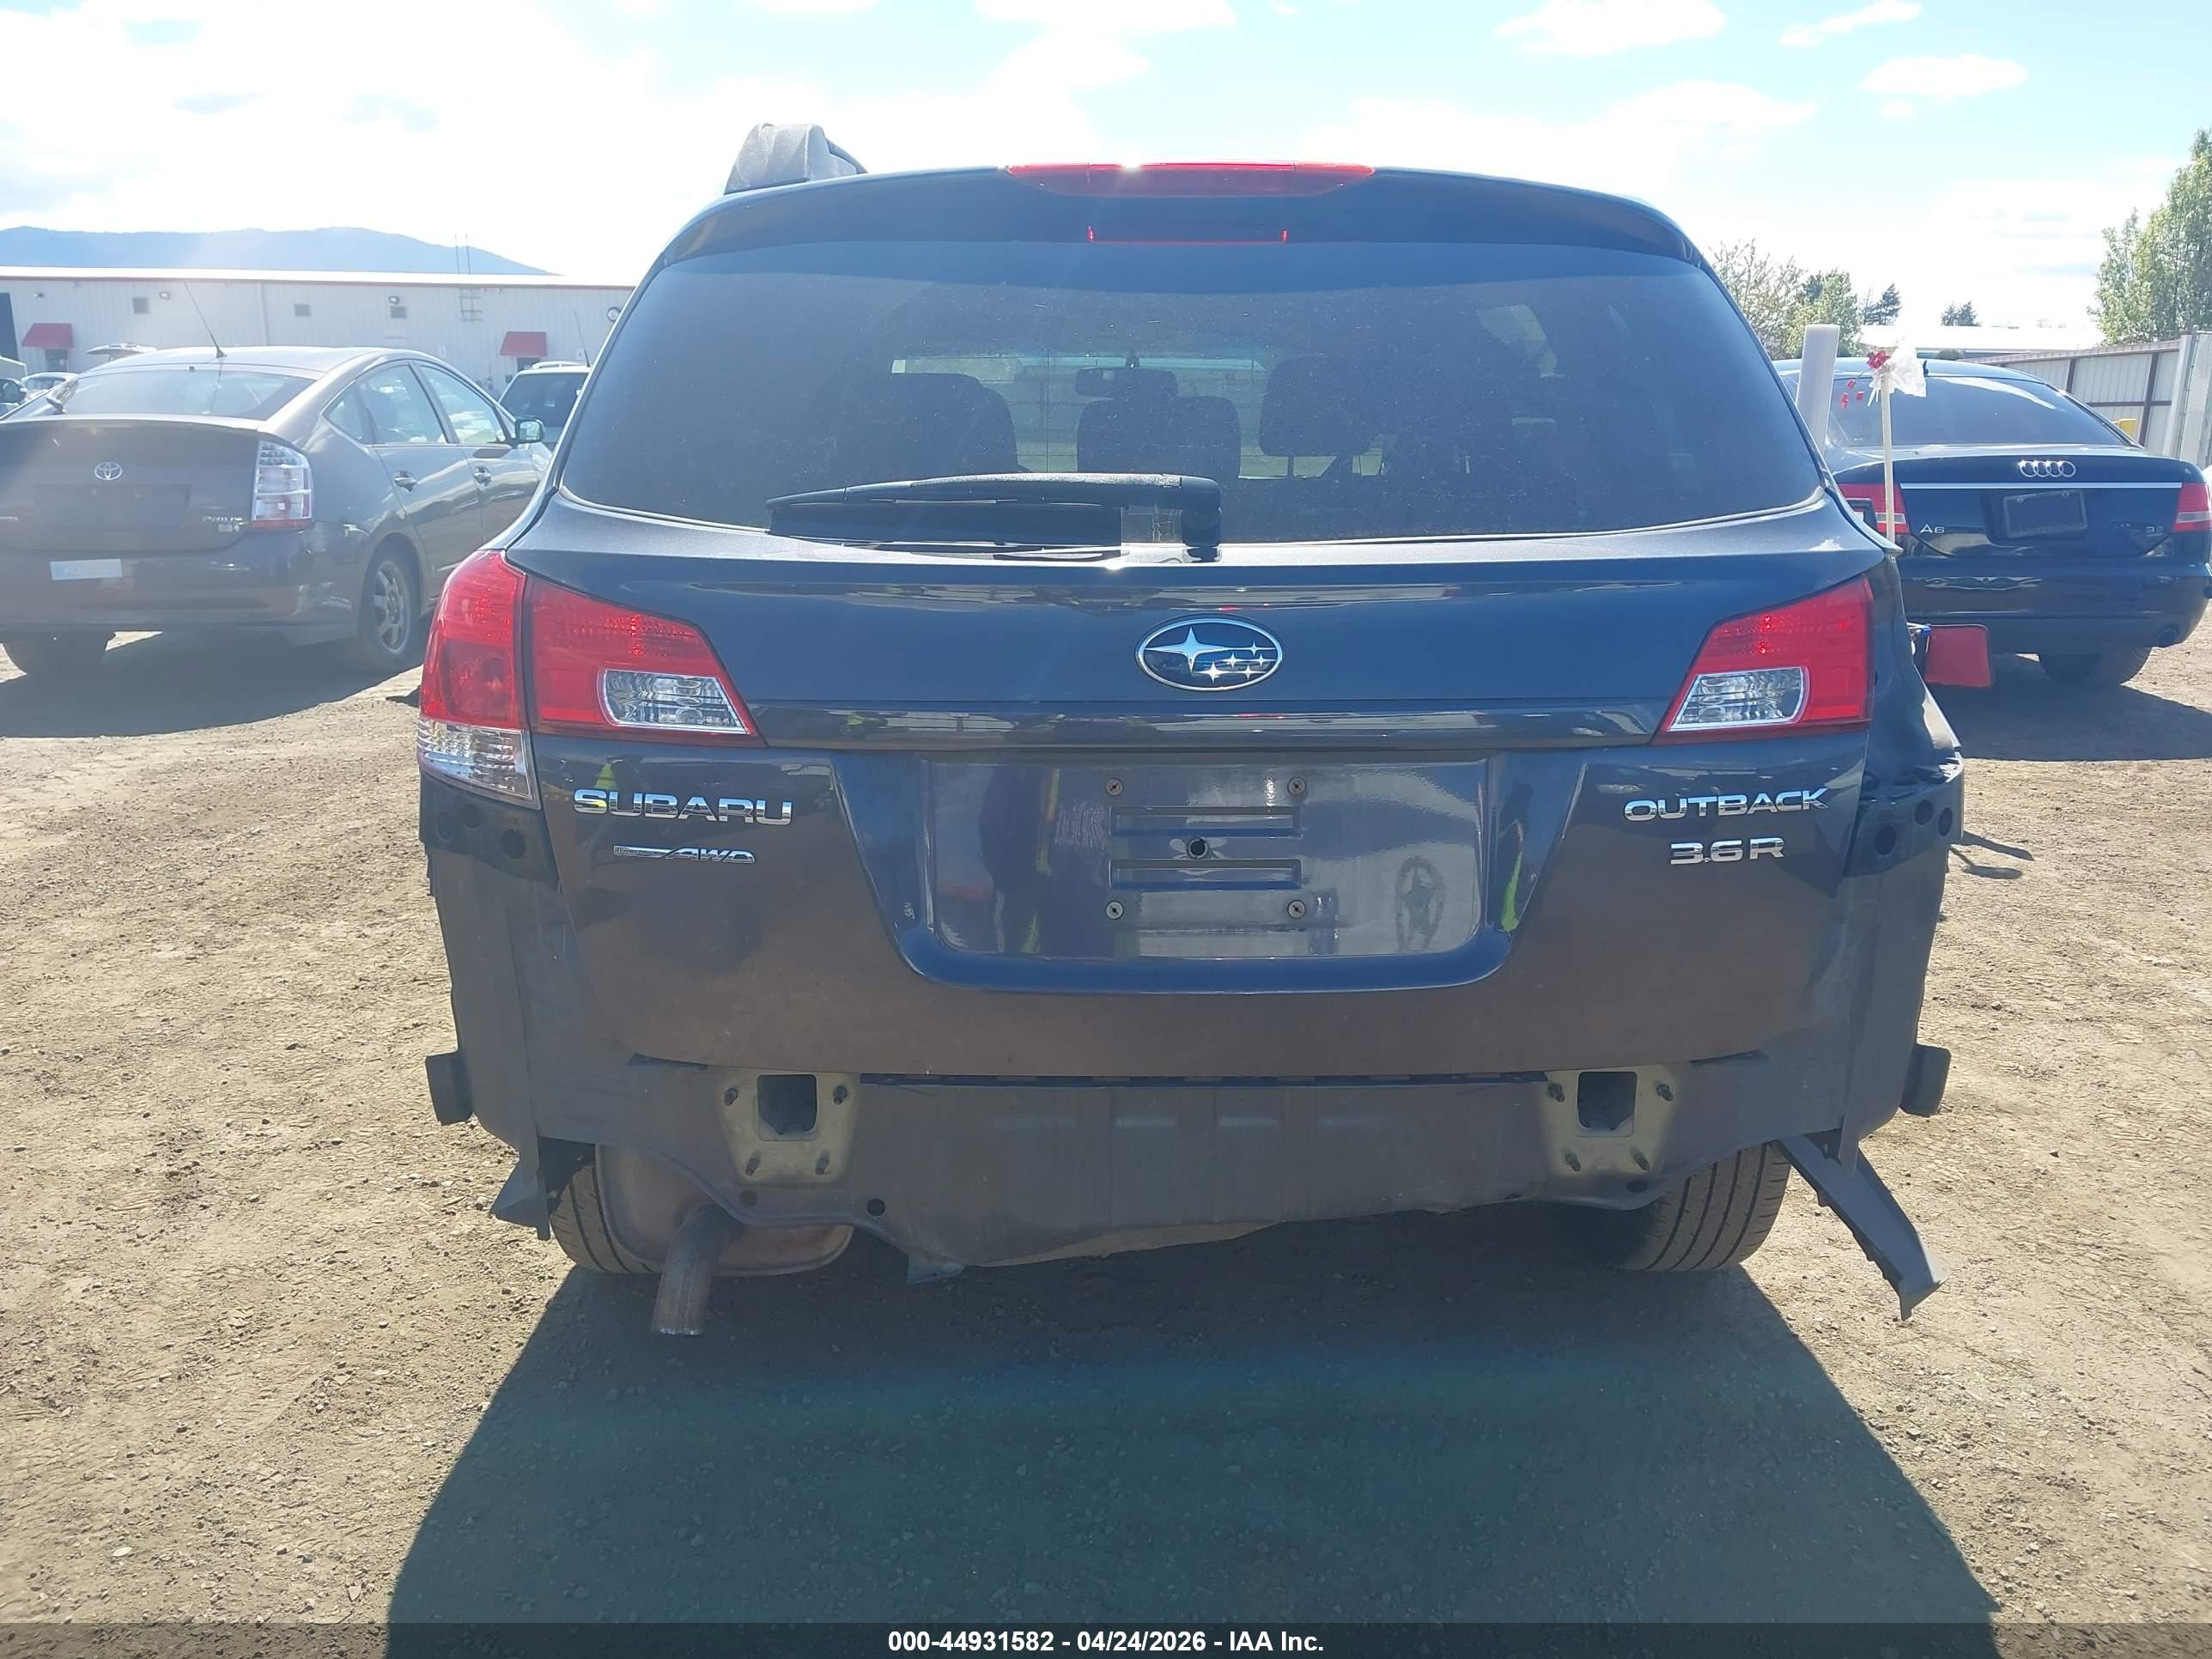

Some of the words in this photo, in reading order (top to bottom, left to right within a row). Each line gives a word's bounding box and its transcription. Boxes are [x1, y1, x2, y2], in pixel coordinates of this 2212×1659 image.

[1920, 523, 1945, 533] A6
[574, 788, 793, 825] SUBARU
[1624, 787, 1829, 821] OUTBACK
[667, 847, 756, 863] AWD
[1670, 836, 1785, 865] 3.6R
